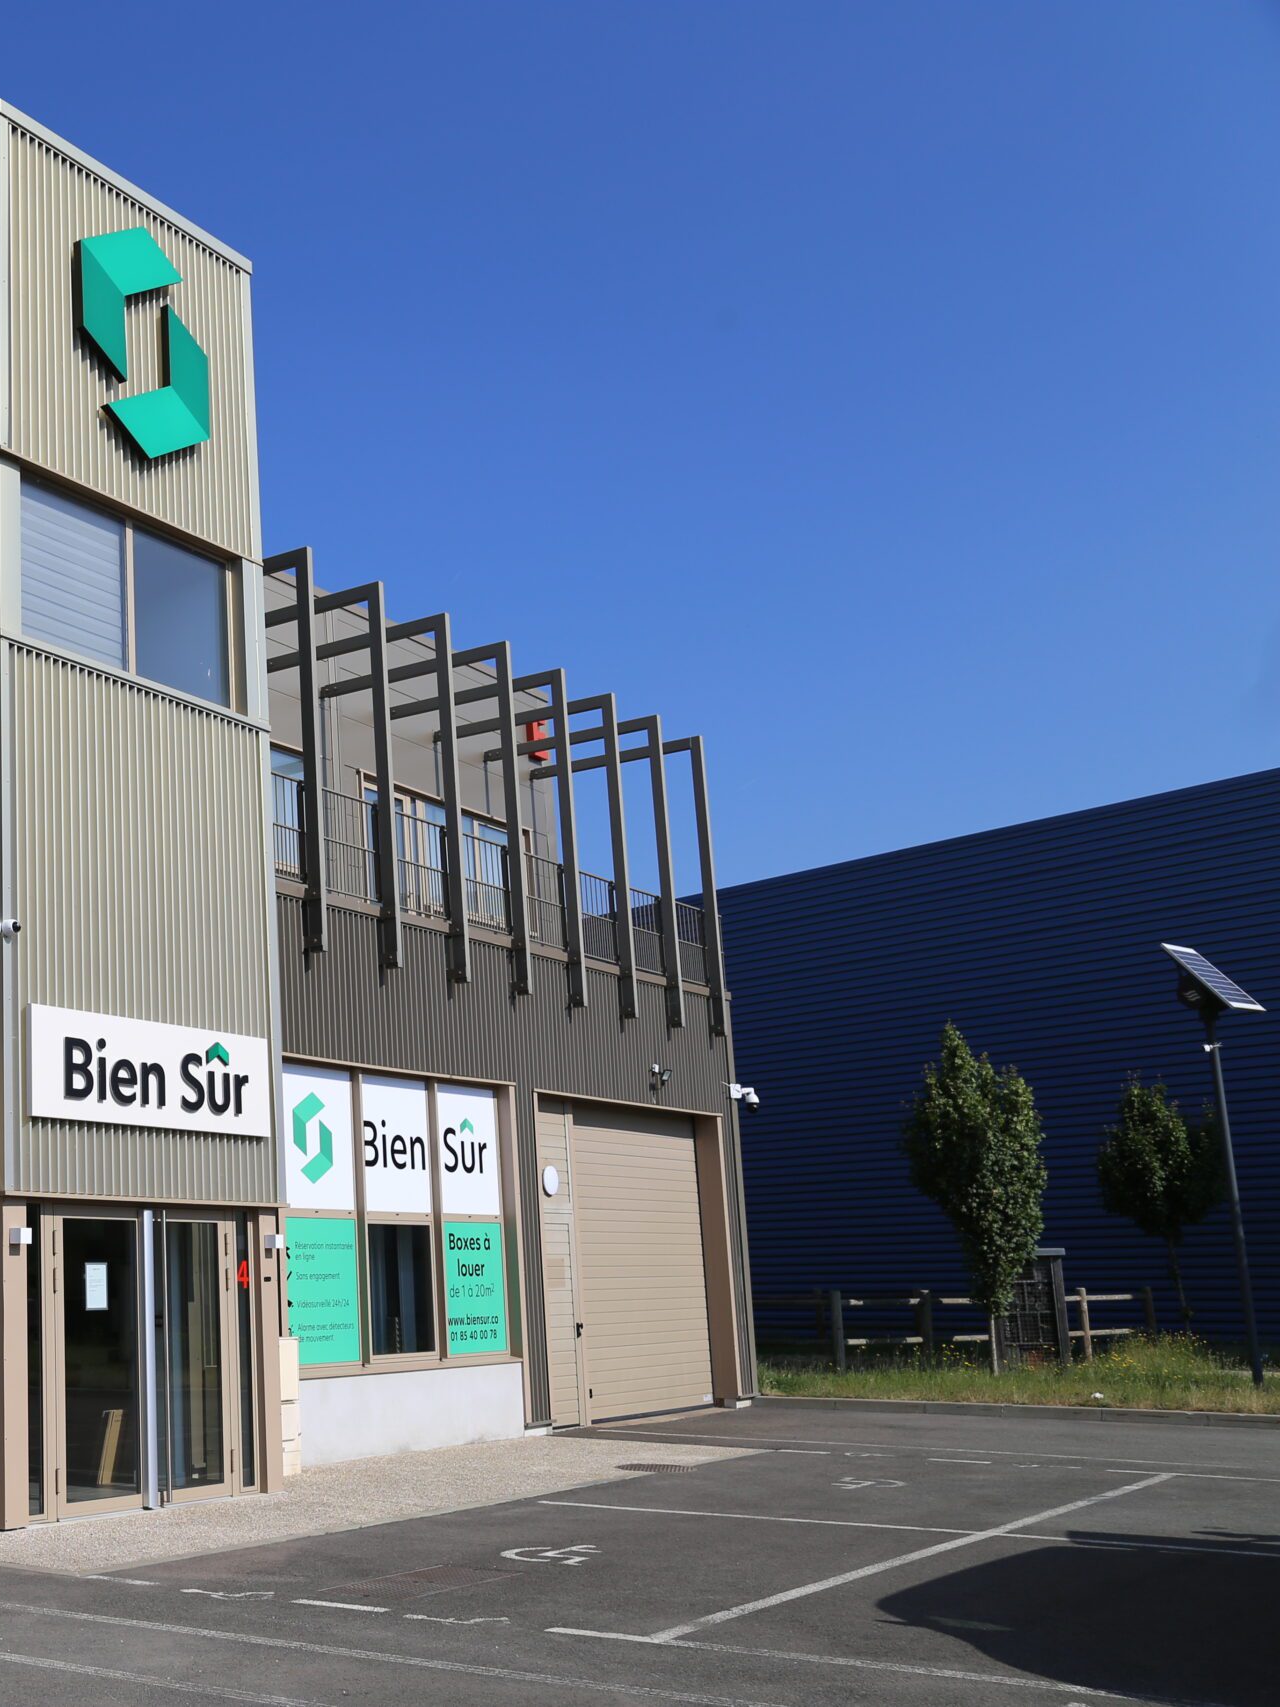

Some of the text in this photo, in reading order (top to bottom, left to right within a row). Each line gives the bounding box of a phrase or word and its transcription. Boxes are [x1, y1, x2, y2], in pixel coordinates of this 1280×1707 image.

[64, 1036, 249, 1116] Bien Sûr
[363, 1118, 487, 1174] Bien Sûr
[448, 1232, 491, 1251] Boxes à
[237, 1260, 250, 1289] 4
[295, 1271, 308, 1280] Sans
[457, 1258, 485, 1277] louer
[450, 1283, 460, 1298] de
[461, 1284, 466, 1298] 1
[468, 1283, 474, 1298] à
[448, 1313, 499, 1327] www.biensur.co
[451, 1329, 498, 1341] 01 85 40 00 78
